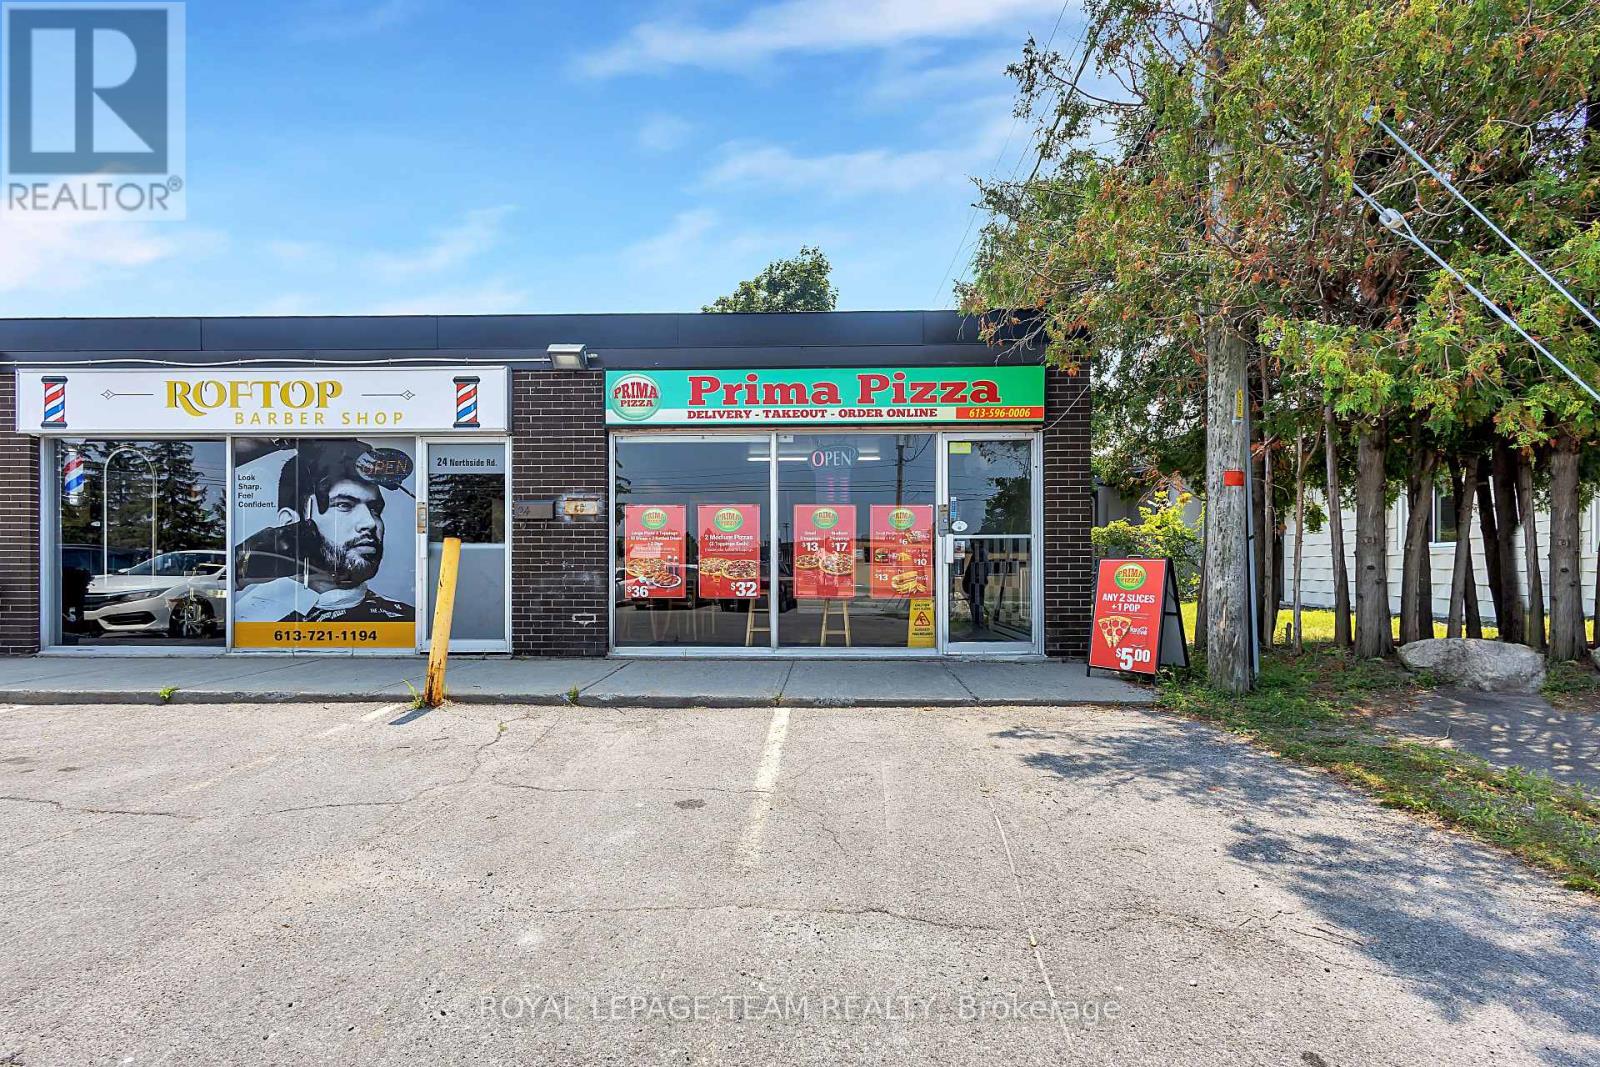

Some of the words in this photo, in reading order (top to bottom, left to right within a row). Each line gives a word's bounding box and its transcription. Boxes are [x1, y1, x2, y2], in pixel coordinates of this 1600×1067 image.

[613, 381, 660, 399] PRIMA
[687, 372, 842, 406] Prima
[856, 371, 1001, 405] Pizza
[165, 380, 344, 417] ROFTOP
[619, 399, 655, 408] PIZZA
[234, 411, 326, 425] BARBER
[341, 411, 404, 425] SHOP
[687, 410, 752, 420] DELIVERY
[763, 409, 828, 419] TAKEOUT
[838, 408, 883, 418] ORDER
[886, 408, 938, 418] ONLINE
[969, 407, 1031, 418] 613-596-0006
[436, 457, 448, 467] 24
[449, 458, 485, 467] Northside
[486, 458, 498, 467] Rd.
[811, 450, 852, 467] OPEN
[238, 483, 262, 491] Sharp.
[1119, 568, 1143, 577] PRIMA
[627, 586, 649, 598] $36
[730, 581, 757, 597] $32
[1103, 593, 1118, 602] ANY
[1119, 593, 1126, 602] 2
[1127, 594, 1155, 603] SLICES
[1123, 604, 1140, 612] POP
[274, 631, 377, 641] 613-721-1194
